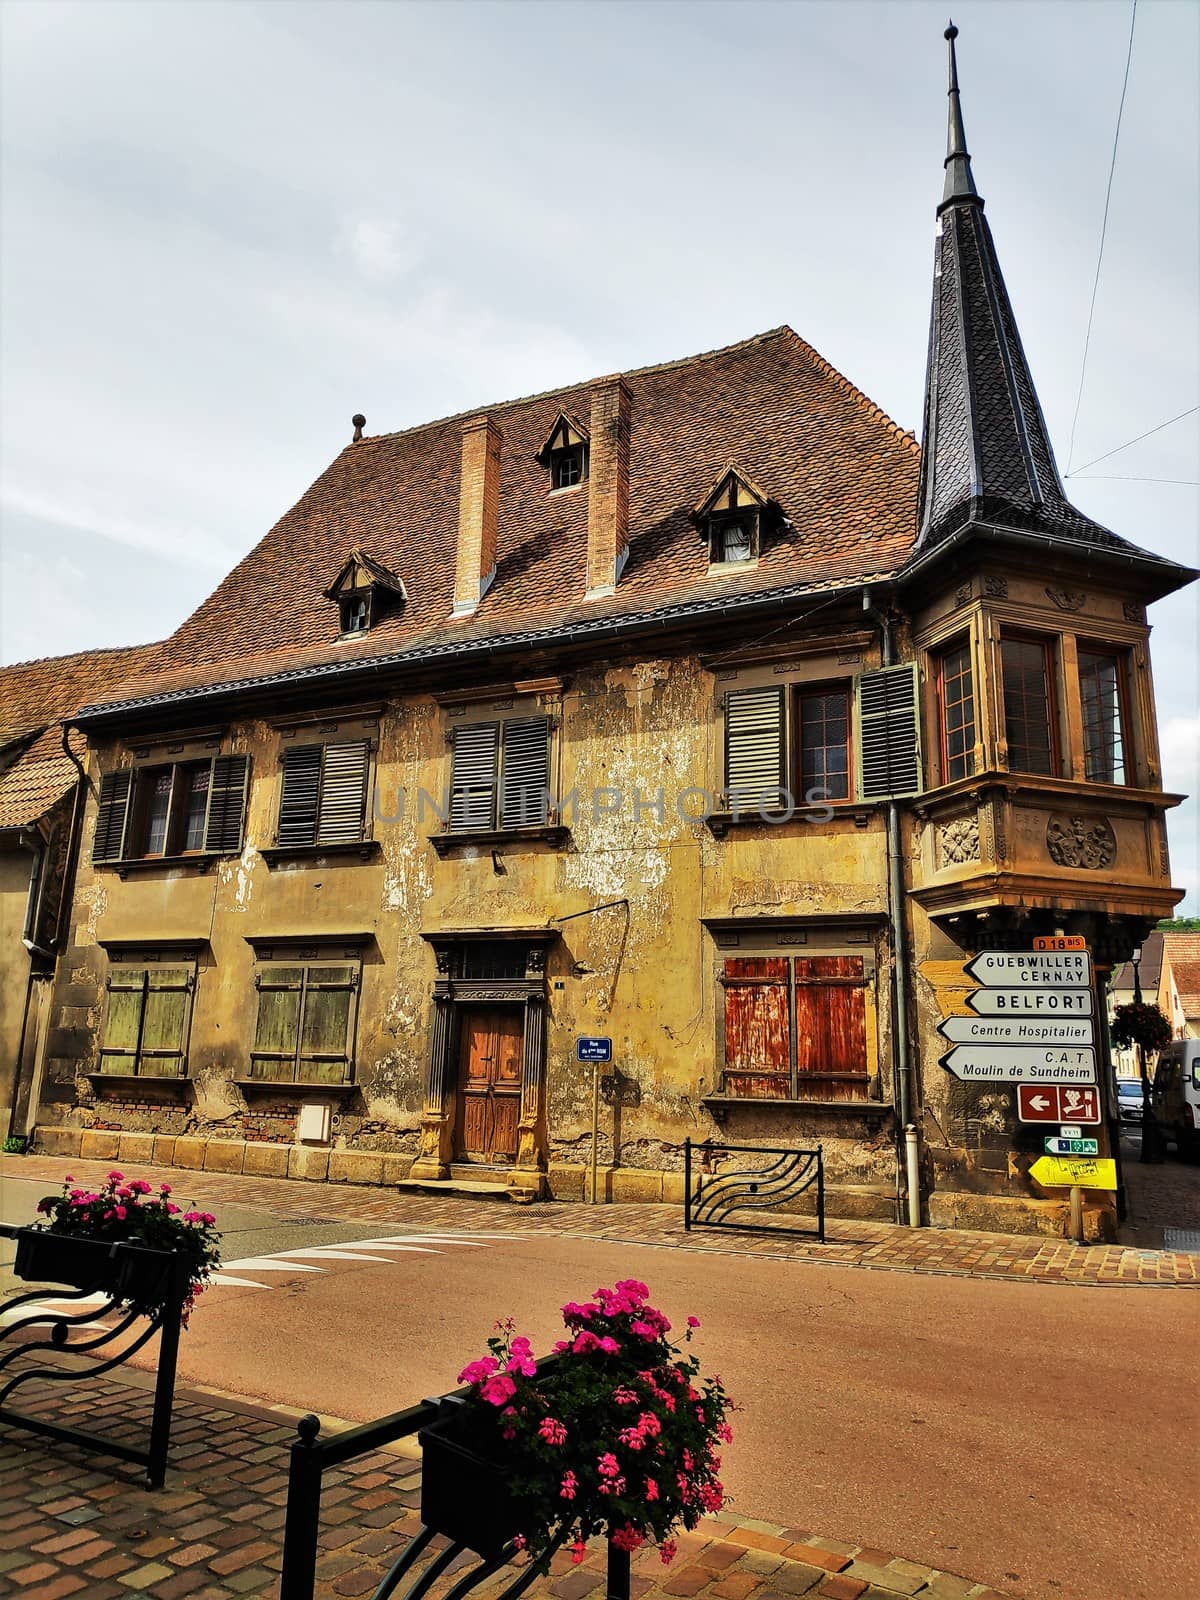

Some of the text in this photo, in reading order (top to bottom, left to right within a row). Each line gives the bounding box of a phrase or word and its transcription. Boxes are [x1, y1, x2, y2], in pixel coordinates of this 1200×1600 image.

[1038, 938, 1081, 950] D 18 BIS
[986, 957, 1083, 968] GUEBWILLER
[1021, 971, 1084, 982] CERNAY
[997, 995, 1085, 1009] BELFORT
[971, 1025, 1087, 1039] Centre Hospitalier
[1045, 1052, 1088, 1064] C.A.T.
[963, 1064, 1090, 1079] Moulin de Sundheim
